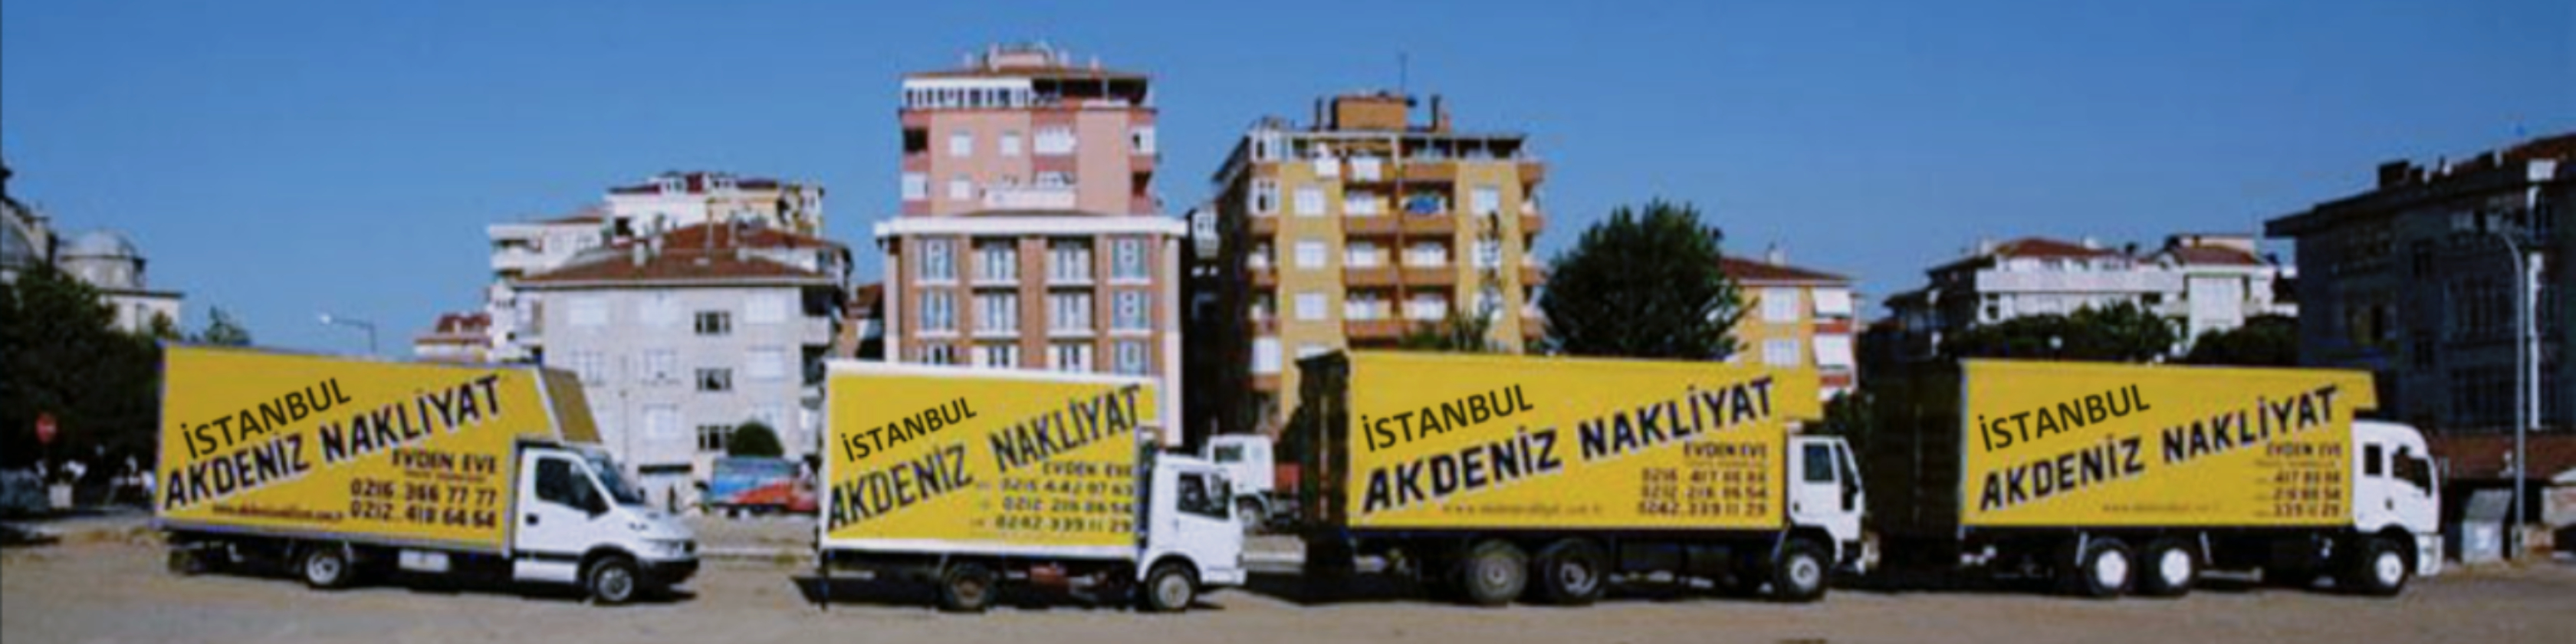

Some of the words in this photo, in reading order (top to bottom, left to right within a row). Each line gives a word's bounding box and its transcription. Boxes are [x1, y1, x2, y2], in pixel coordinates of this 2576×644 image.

[165, 429, 310, 509] AKDENİZ
[318, 374, 498, 463] NAKLİYAT
[181, 378, 351, 458] İSTANBUL
[828, 442, 974, 532] AKDENİZ
[988, 383, 1141, 473] NAKLİYAT
[841, 398, 977, 462] İSTANBUL
[1362, 384, 1533, 452] İSTANBUL
[1362, 426, 1561, 514] AKDENİZ
[1578, 377, 1774, 462] NAKLİYAT
[1978, 384, 2150, 452] İSTANBUL
[1980, 435, 2144, 511] AKDENİZ
[2162, 386, 2338, 464] NAKLİYAT
[351, 477, 394, 498] 0216
